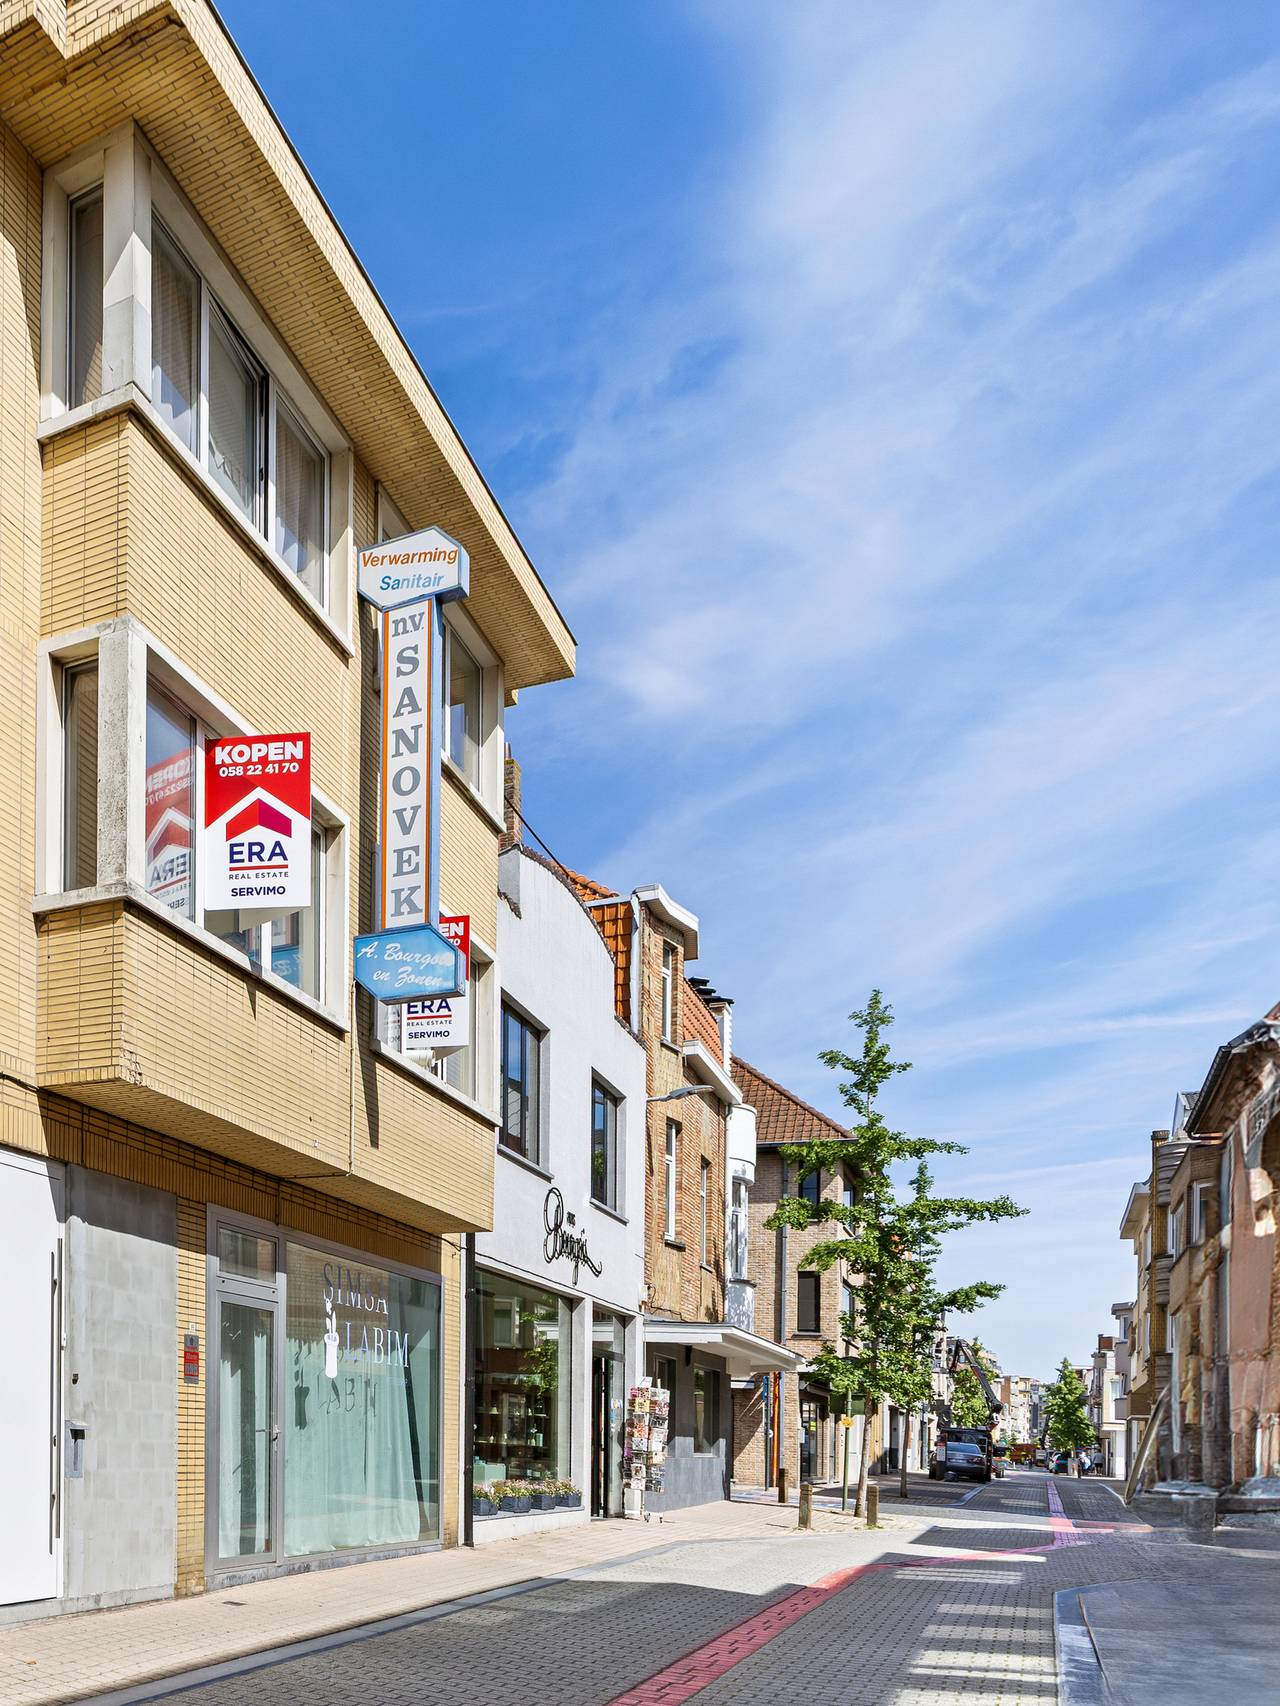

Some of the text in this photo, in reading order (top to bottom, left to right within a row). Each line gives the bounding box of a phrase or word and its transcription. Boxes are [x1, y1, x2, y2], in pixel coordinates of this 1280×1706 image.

[362, 547, 458, 567] Verwarming
[380, 573, 444, 590] Sanitair
[215, 741, 304, 765] KOPEN
[219, 762, 300, 777] 058 22 41 70
[391, 644, 423, 917] SANOVEK
[229, 840, 289, 864] ERA
[255, 871, 289, 879] ESTATE
[231, 885, 286, 897] SERVIMO
[357, 941, 378, 959] A.
[373, 969, 391, 981] en
[407, 999, 452, 1015] ERA
[408, 1030, 450, 1039] SERVIMO
[344, 1322, 409, 1368] LABIM
